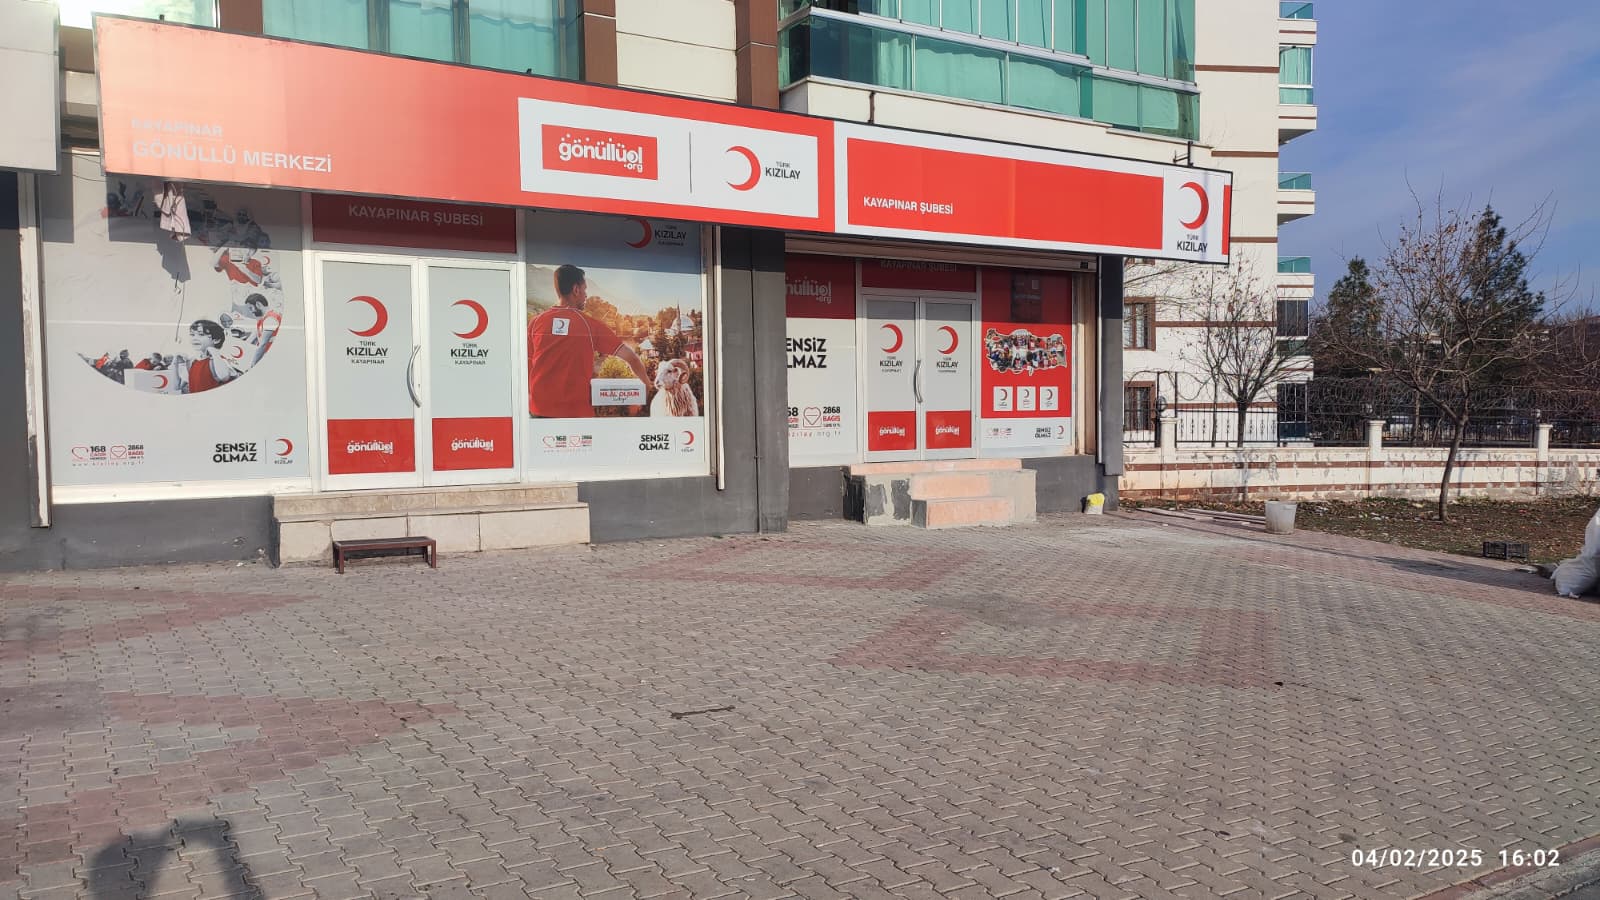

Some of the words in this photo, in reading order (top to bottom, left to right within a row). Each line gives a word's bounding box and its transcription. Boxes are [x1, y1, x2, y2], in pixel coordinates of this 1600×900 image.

[131, 117, 223, 137] KAYAPINAR
[132, 137, 237, 164] GÖNÜLLÜ
[243, 149, 332, 173] MERKEZİ
[765, 167, 801, 180] KIZILAY
[863, 196, 918, 211] KAYAPINAR
[919, 202, 954, 215] ŞUBESİ
[348, 205, 430, 222] KAYAPINAR
[433, 212, 484, 226] ŞUBESİ
[654, 230, 687, 240] KIZILAY
[1176, 240, 1208, 253] KIZILAY
[346, 347, 389, 357] KIZILAY
[450, 348, 489, 358] KIZILAY
[879, 359, 903, 367] KIZILAY
[823, 406, 841, 414] 2868
[90, 445, 106, 453] 168
[639, 442, 670, 451] OLMAZ
[212, 453, 257, 463] OLMAZ
